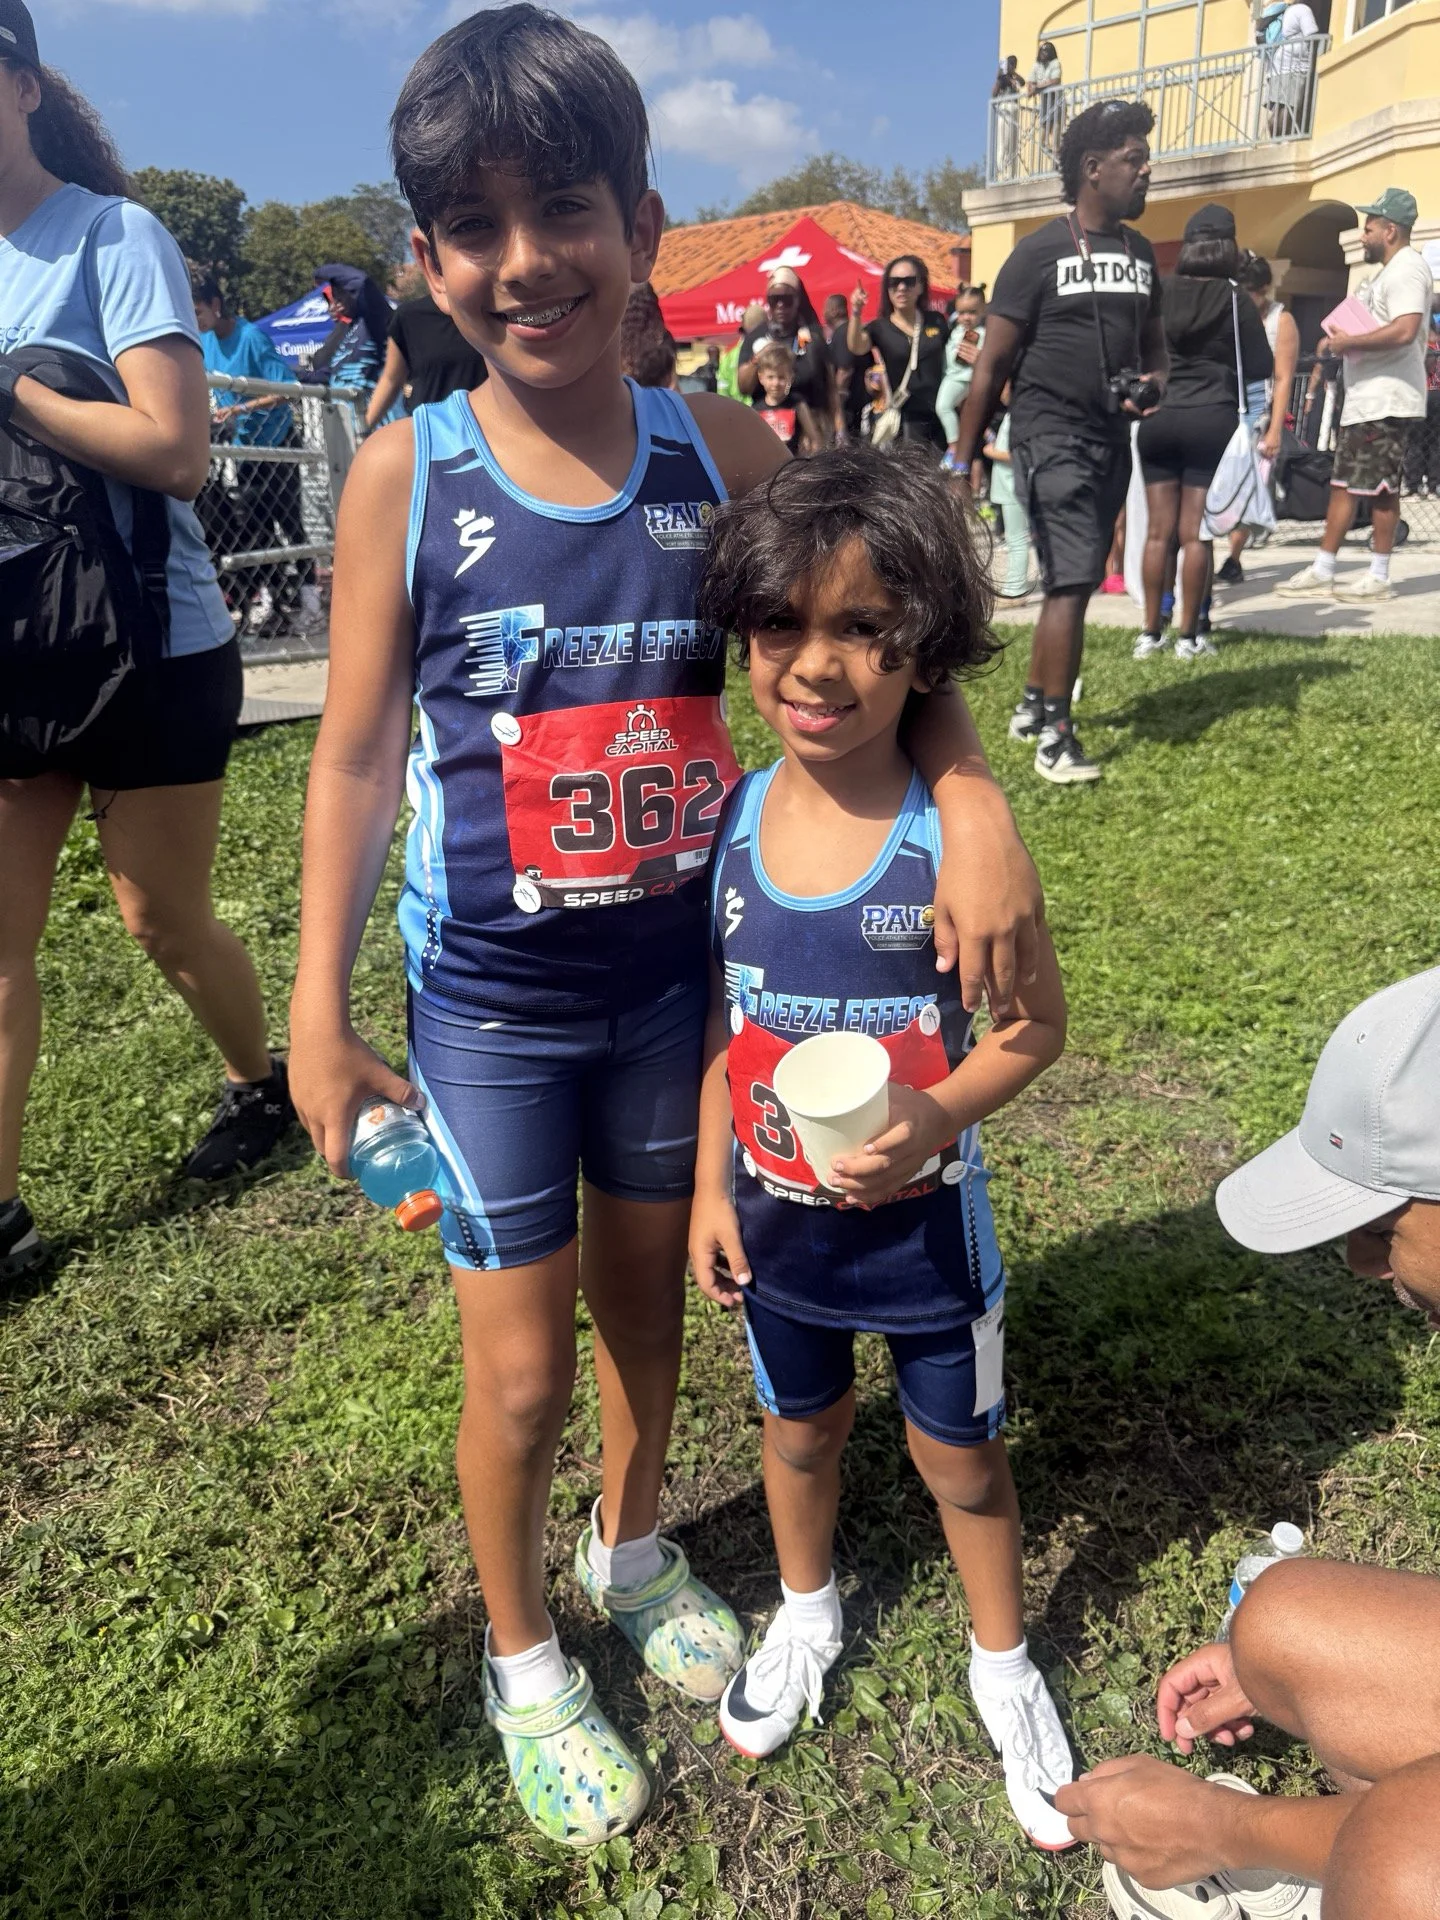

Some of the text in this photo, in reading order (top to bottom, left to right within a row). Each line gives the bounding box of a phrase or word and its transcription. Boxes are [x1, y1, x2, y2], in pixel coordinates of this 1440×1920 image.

[614, 728, 671, 745] SPEED
[605, 739, 679, 758] CAPITAL
[549, 758, 727, 854] 362
[563, 887, 645, 908] SPEED
